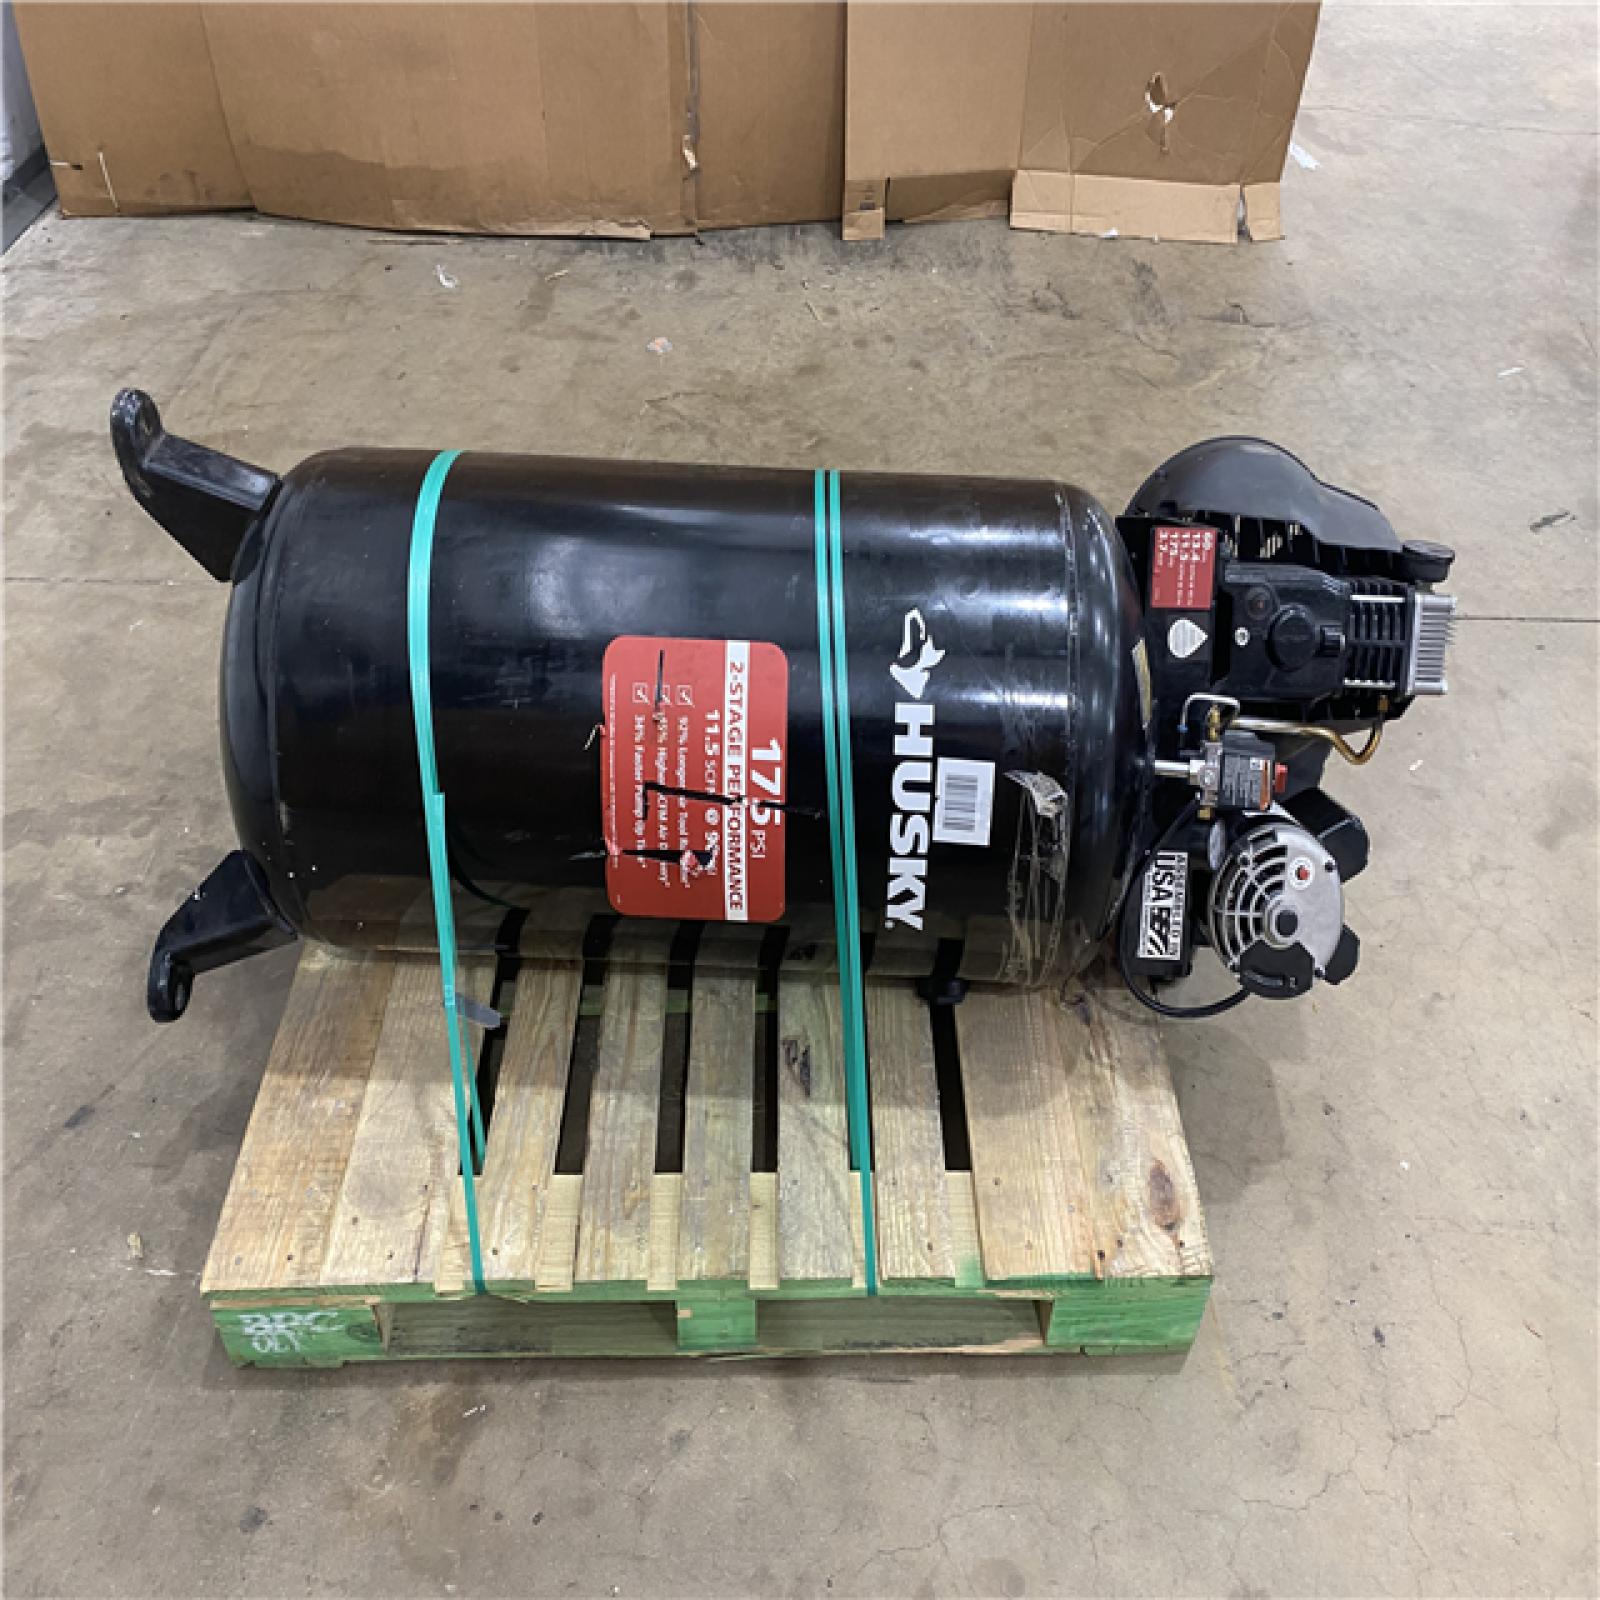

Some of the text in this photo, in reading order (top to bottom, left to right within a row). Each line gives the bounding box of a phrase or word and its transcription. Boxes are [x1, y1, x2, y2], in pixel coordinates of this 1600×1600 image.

[705, 709, 721, 756] 11.5
[728, 661, 745, 758] 2-STAGE
[750, 739, 782, 859] 175 PSI
[885, 702, 935, 931] HUSKY
[1151, 854, 1176, 902] USA
